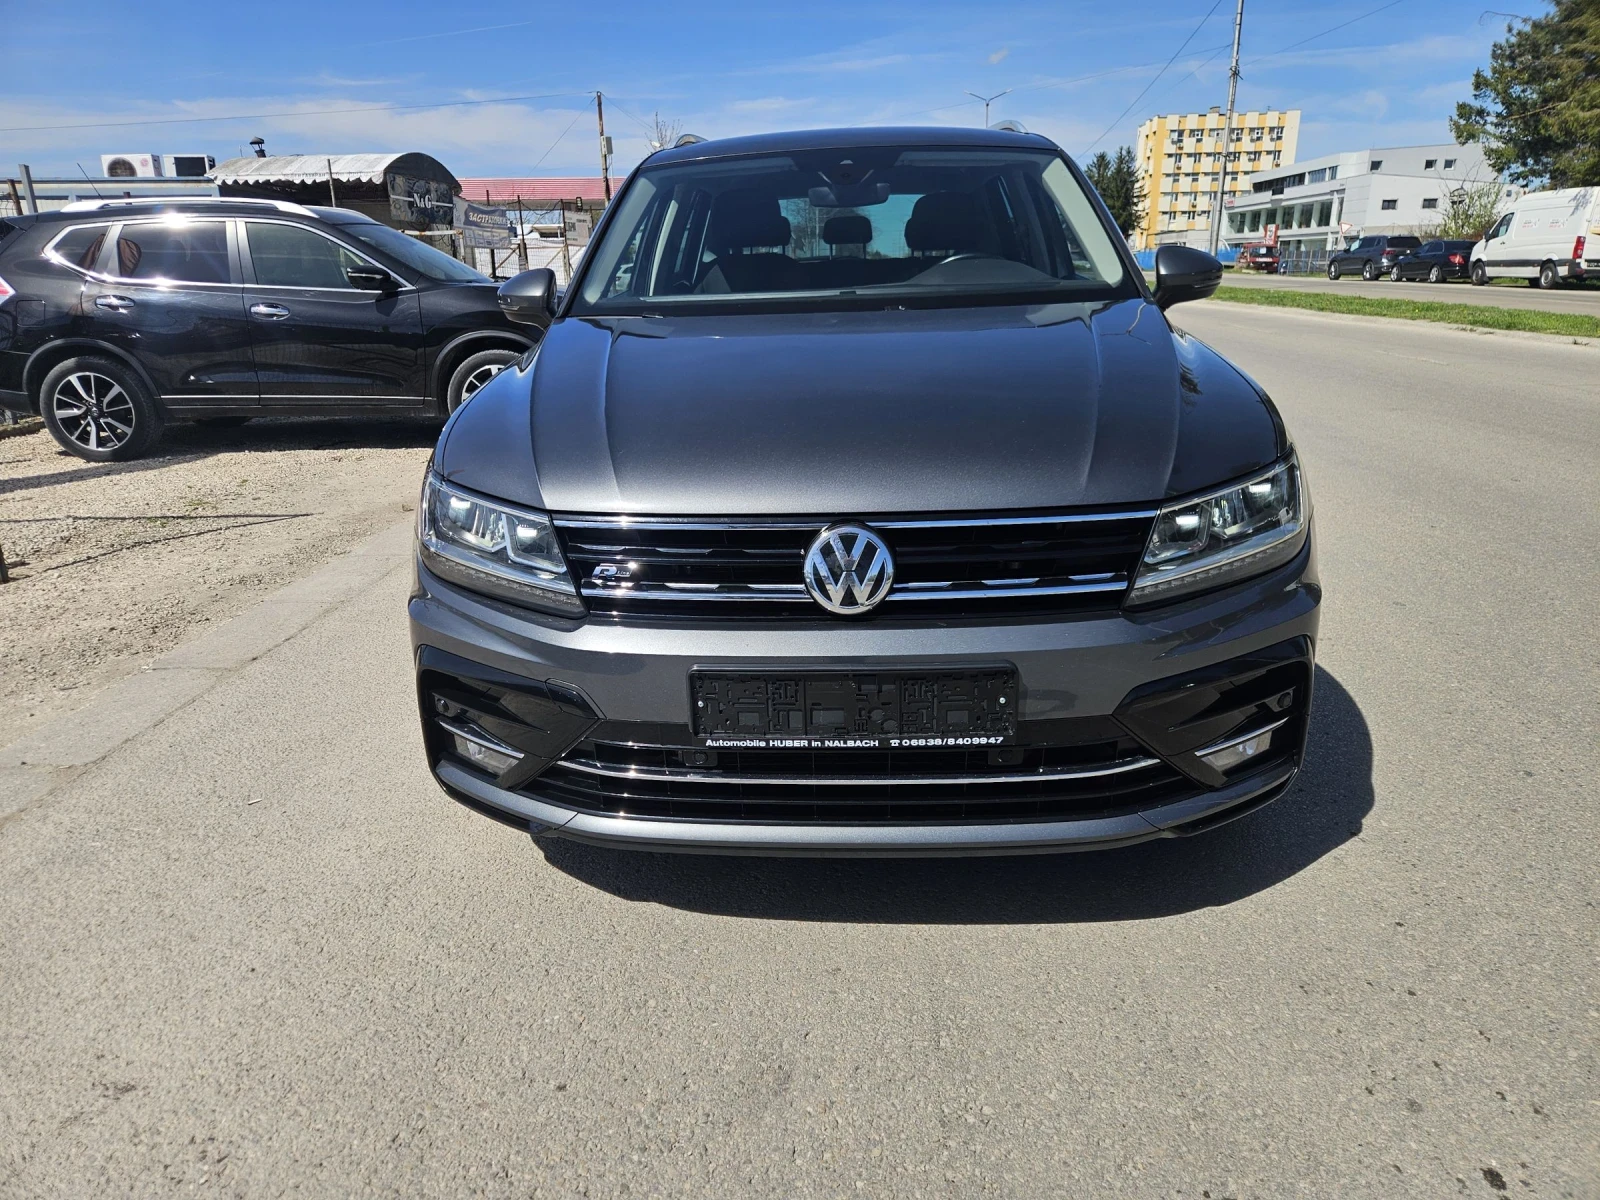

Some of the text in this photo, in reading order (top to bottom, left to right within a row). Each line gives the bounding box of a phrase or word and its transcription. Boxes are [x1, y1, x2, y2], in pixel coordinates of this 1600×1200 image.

[705, 737, 1005, 748] Automobile HUBER in NALBACH 06838/8409947
